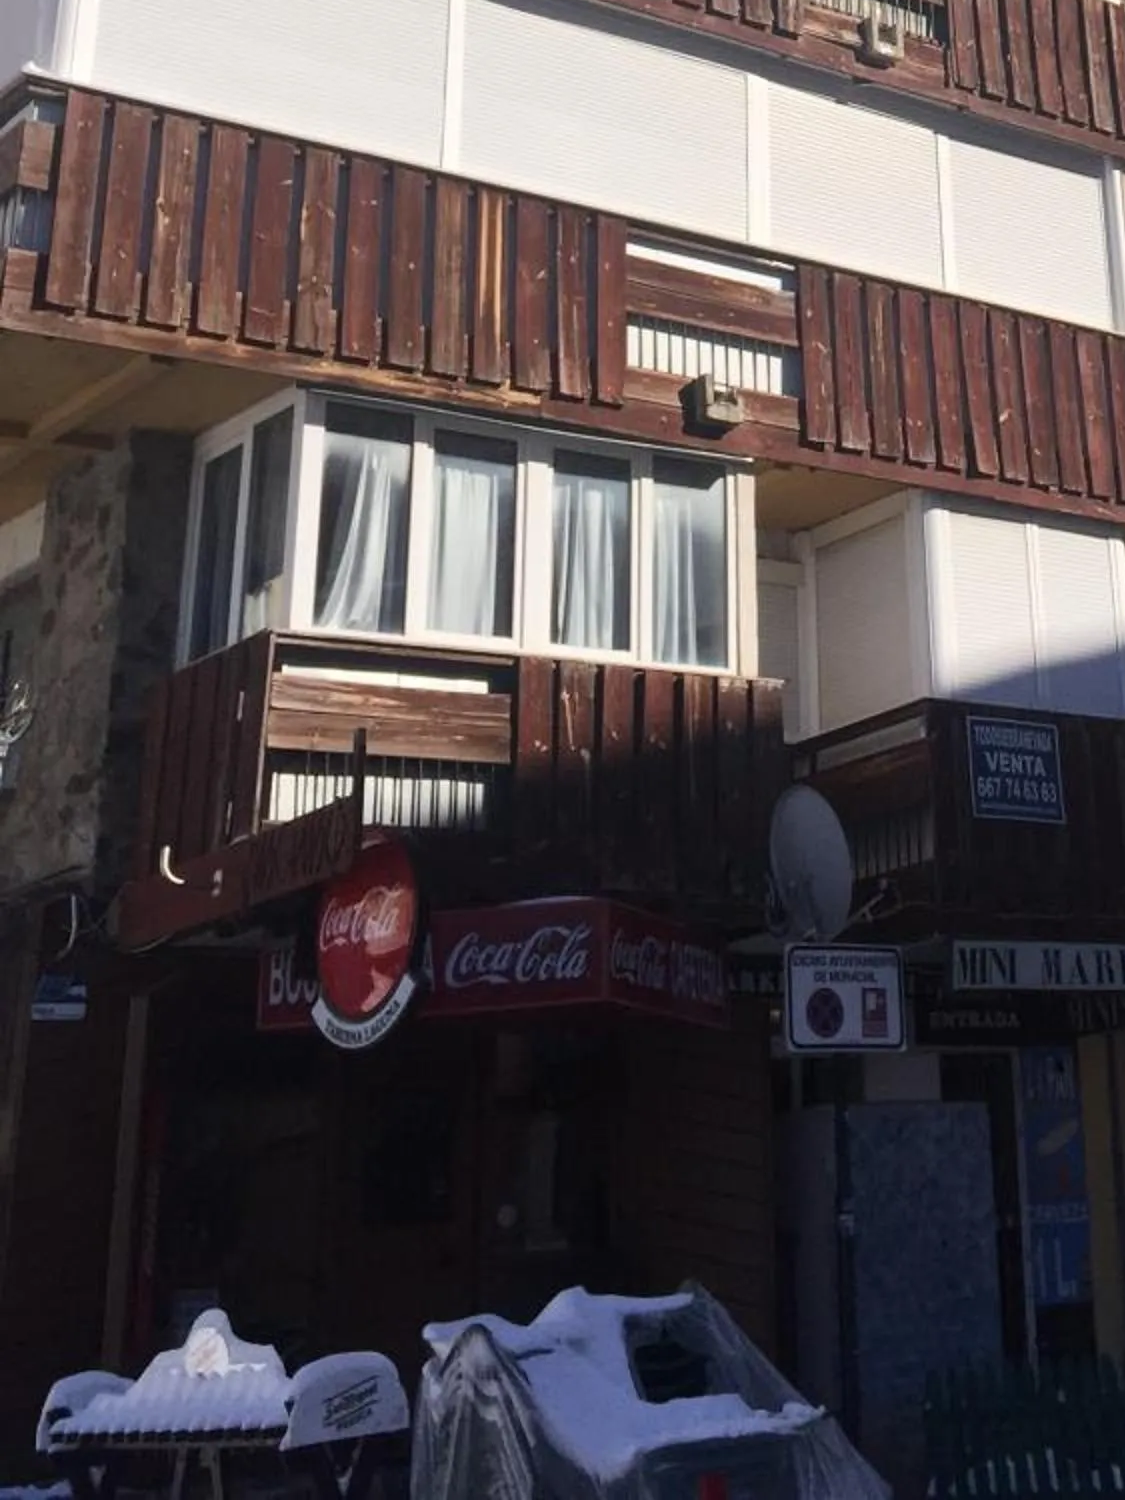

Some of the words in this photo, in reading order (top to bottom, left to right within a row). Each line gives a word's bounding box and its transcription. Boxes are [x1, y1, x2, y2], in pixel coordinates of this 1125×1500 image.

[983, 750, 1047, 777] VENTA
[976, 775, 1001, 799] 667
[1004, 778, 1021, 800] 74
[957, 947, 1018, 986] MINI
